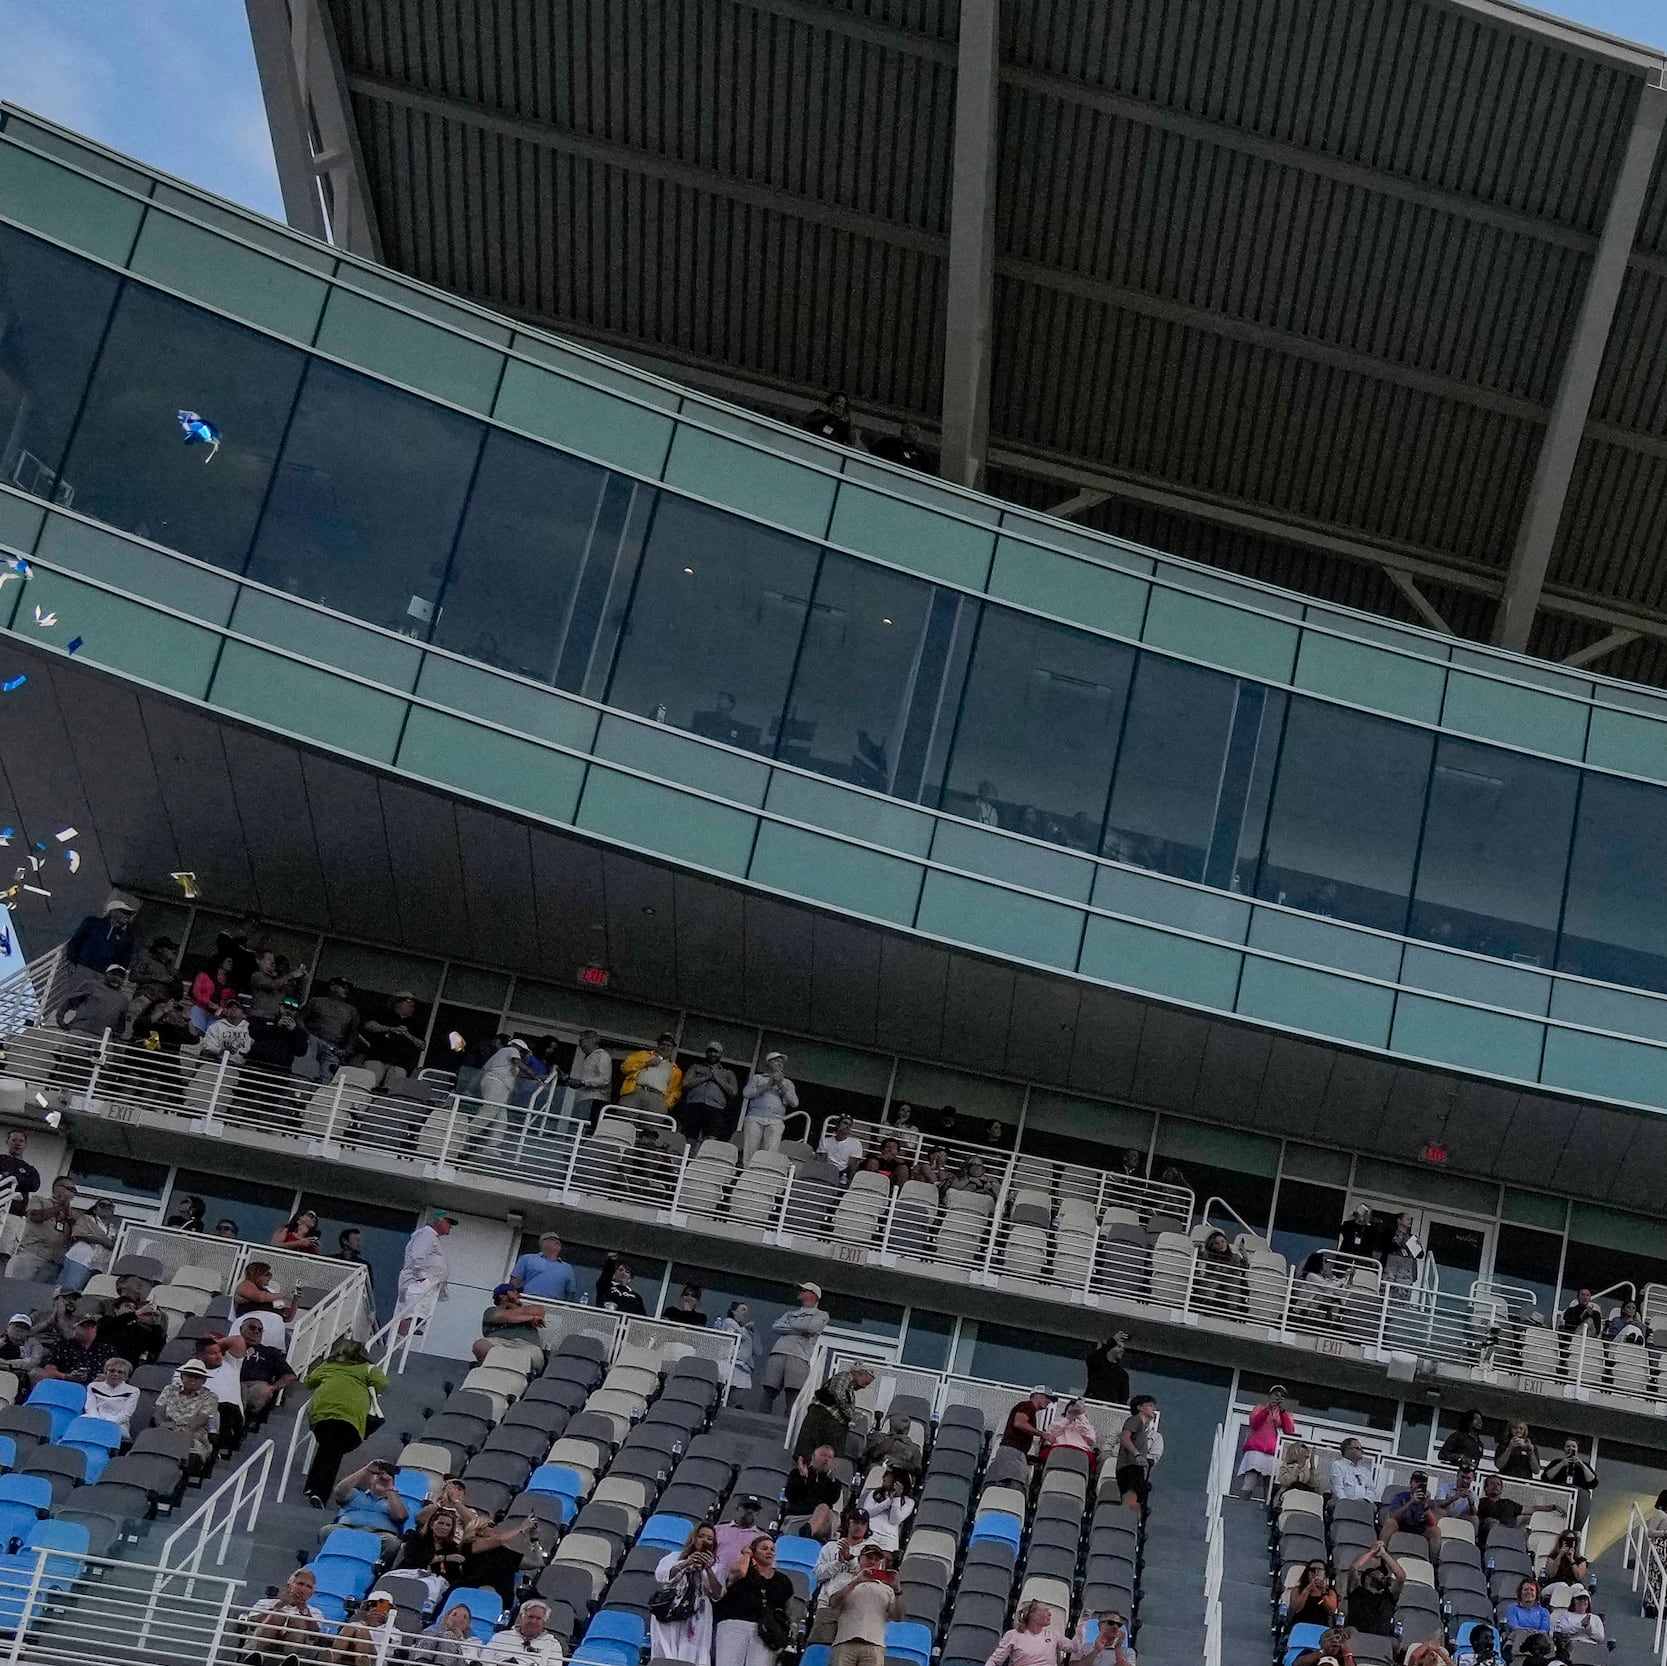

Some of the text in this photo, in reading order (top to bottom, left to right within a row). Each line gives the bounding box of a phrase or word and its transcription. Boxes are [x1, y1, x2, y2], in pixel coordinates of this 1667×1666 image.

[582, 968, 607, 984] EXIT
[109, 1104, 136, 1123] EXIT
[839, 1246, 863, 1263] EXIT
[1322, 1339, 1345, 1356] EXIT
[1524, 1378, 1546, 1394] EXIT
